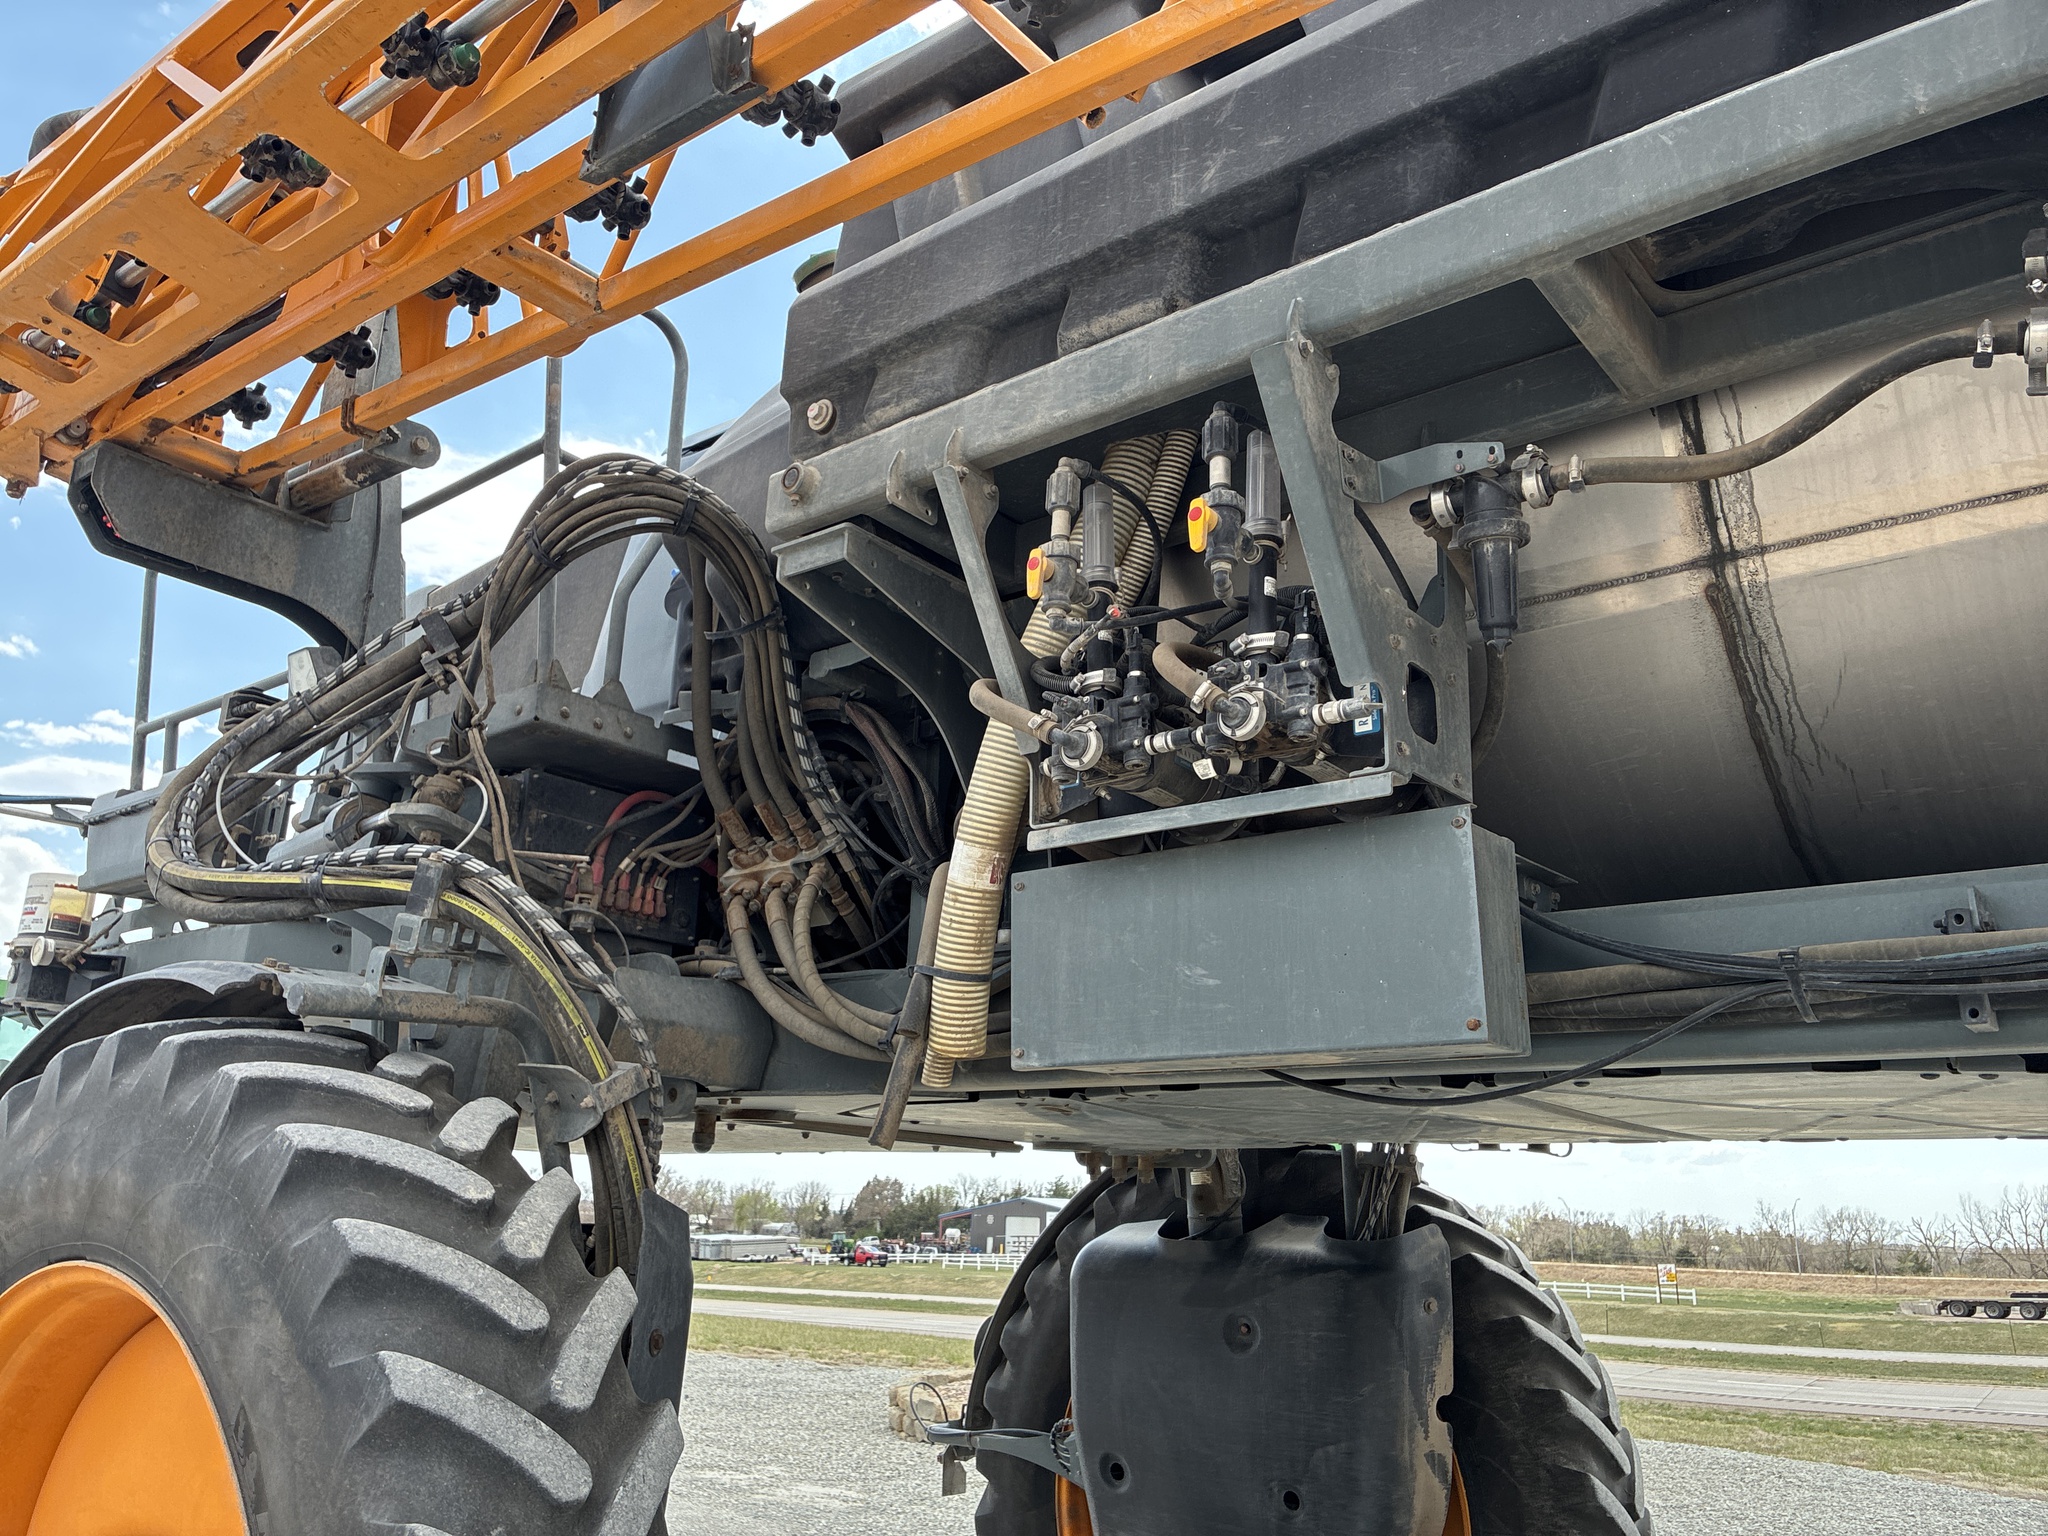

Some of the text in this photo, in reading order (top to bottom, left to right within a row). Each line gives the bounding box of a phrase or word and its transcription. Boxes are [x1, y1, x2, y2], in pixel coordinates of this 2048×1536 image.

[465, 902, 478, 912] MPa
[478, 909, 486, 917] 42
[530, 954, 545, 971] MSHA
